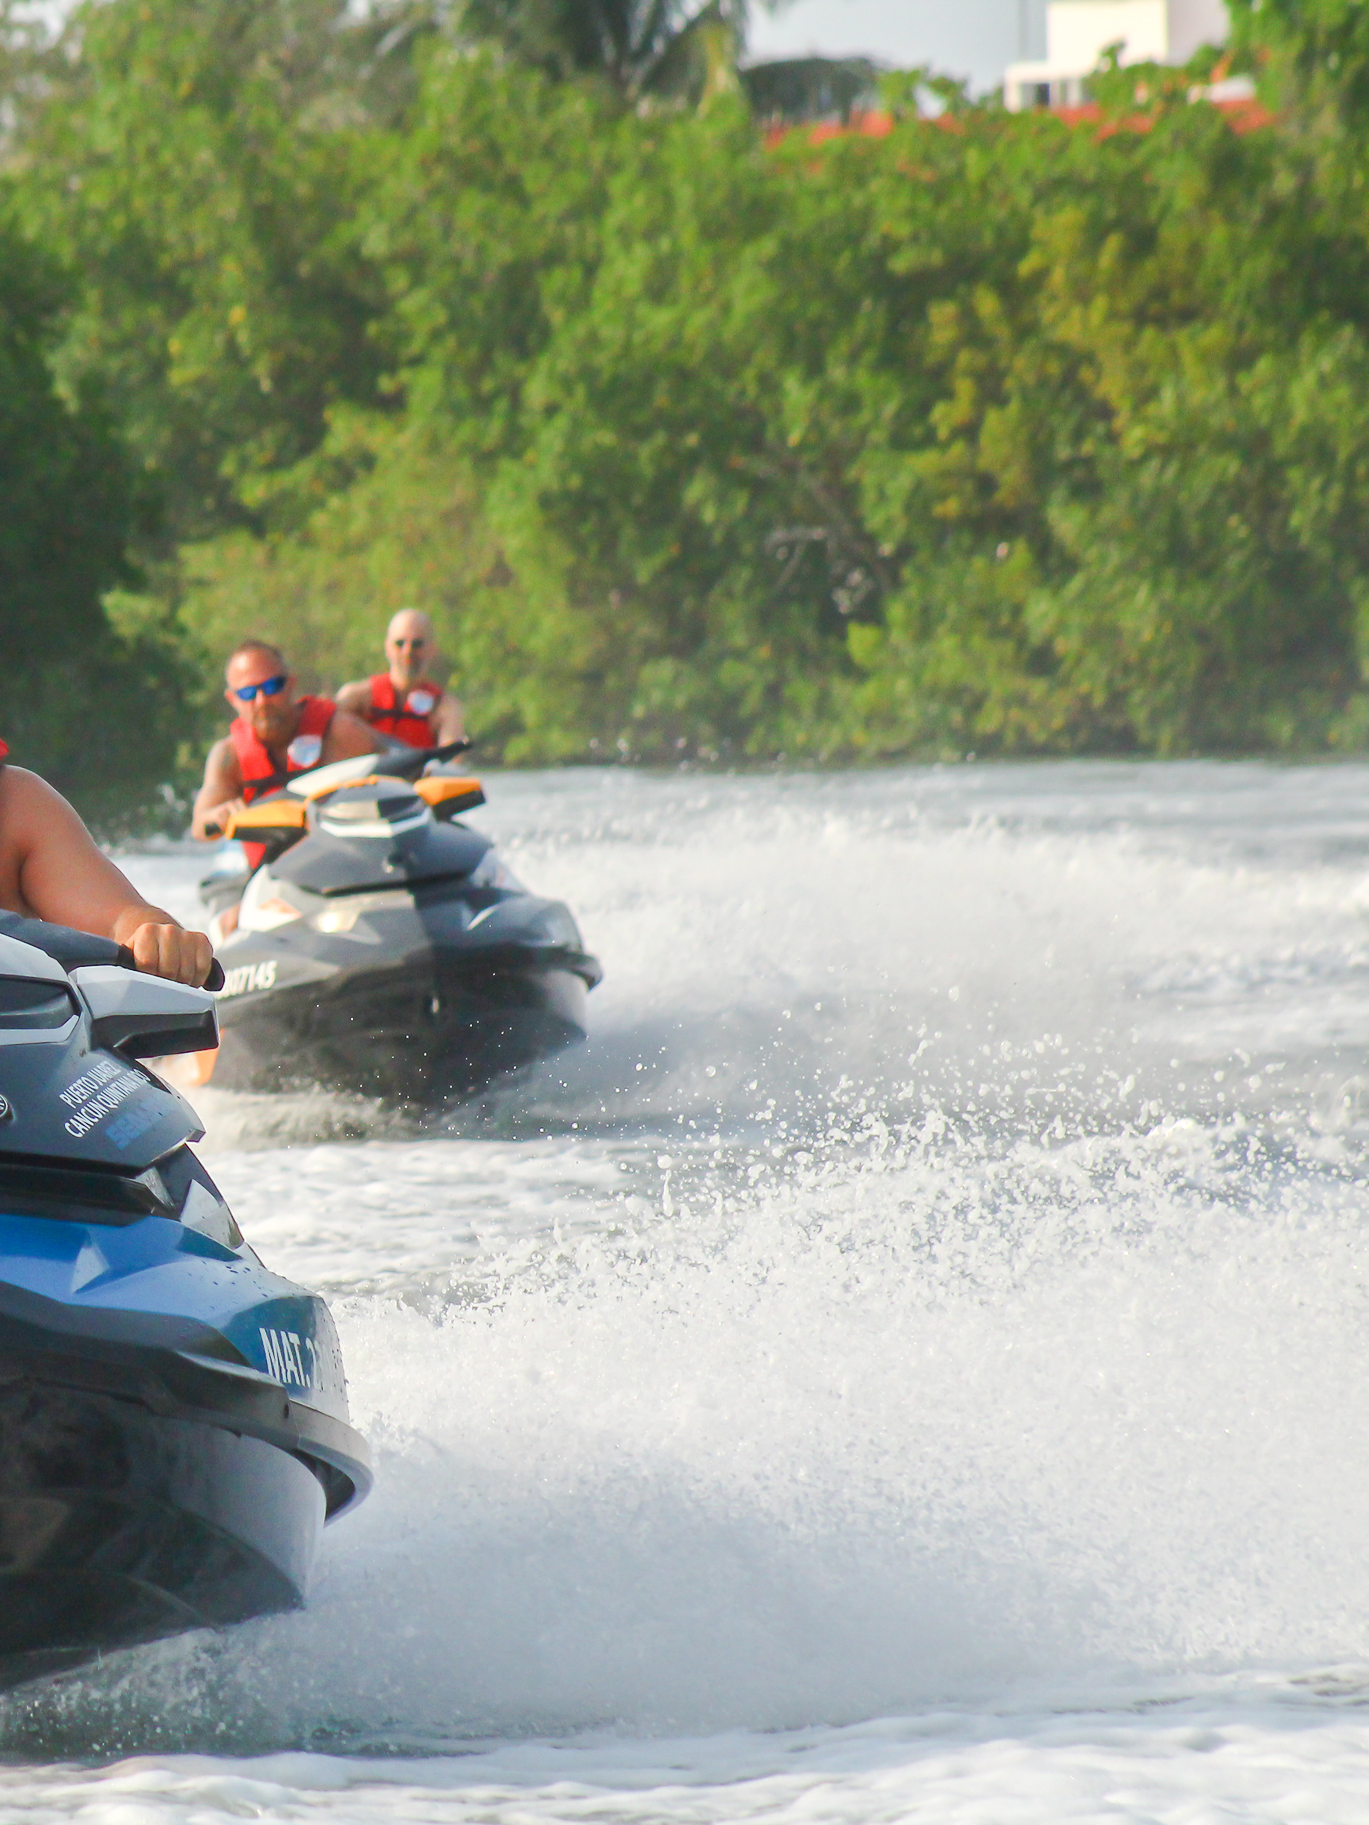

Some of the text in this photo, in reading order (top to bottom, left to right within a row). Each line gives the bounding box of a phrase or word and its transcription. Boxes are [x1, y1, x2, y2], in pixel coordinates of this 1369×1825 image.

[59, 1060, 121, 1109] PUERTO JUAREZ
[64, 1098, 109, 1138] CANCUN
